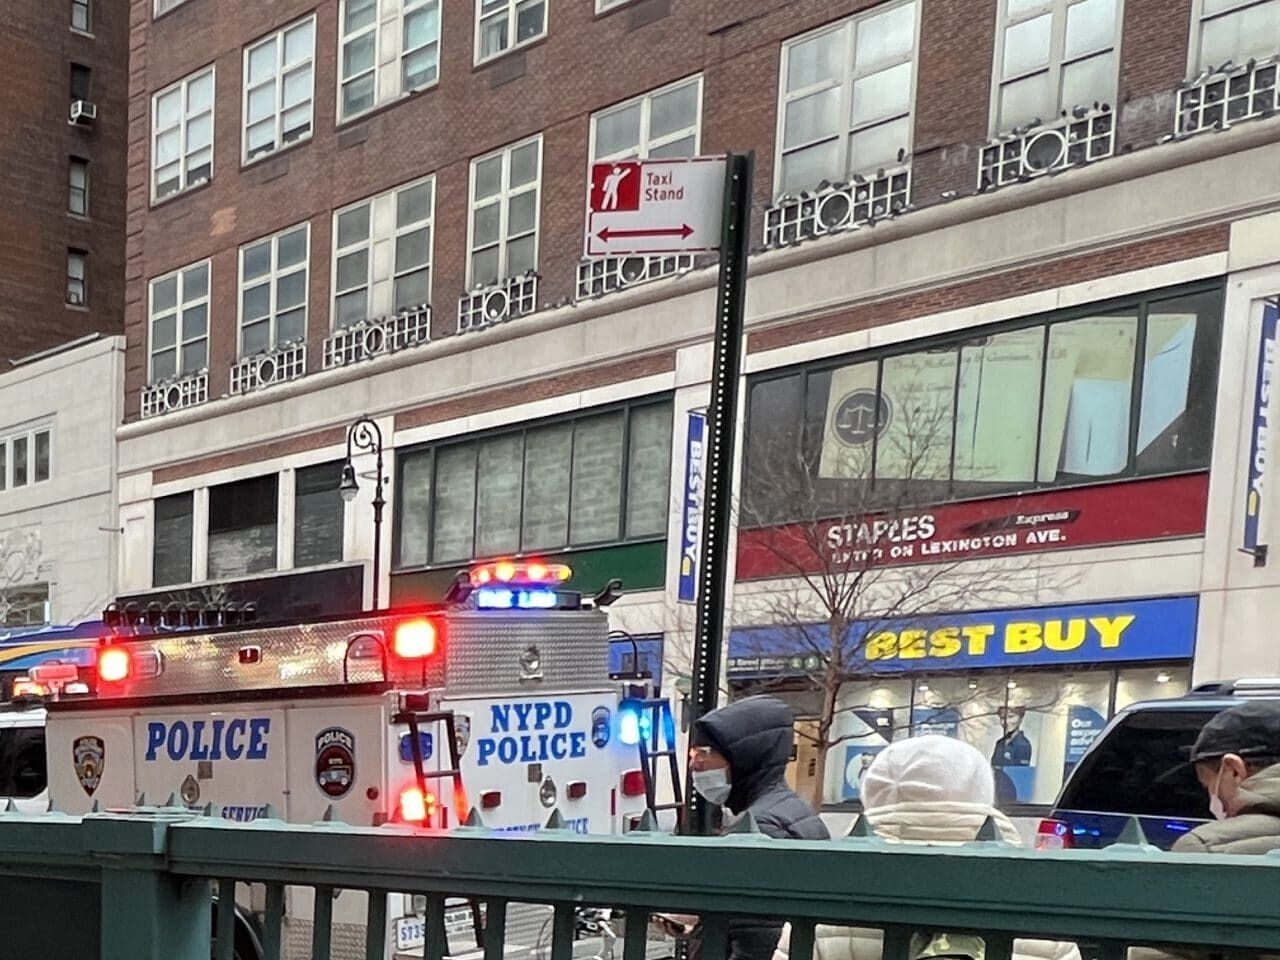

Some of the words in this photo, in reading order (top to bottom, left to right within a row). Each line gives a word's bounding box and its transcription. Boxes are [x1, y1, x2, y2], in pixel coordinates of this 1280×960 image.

[645, 187, 684, 201] Stand
[646, 170, 673, 186] Taxi
[827, 514, 936, 549] STAPLES
[889, 543, 915, 559] ON
[921, 532, 1018, 556] LEXINGTON
[1025, 528, 1067, 545] AVE.
[864, 624, 996, 662] BEST
[1003, 613, 1138, 655] BUY
[490, 701, 573, 733] NYPD
[145, 718, 271, 762] POLICE
[477, 732, 587, 767] POLICE
